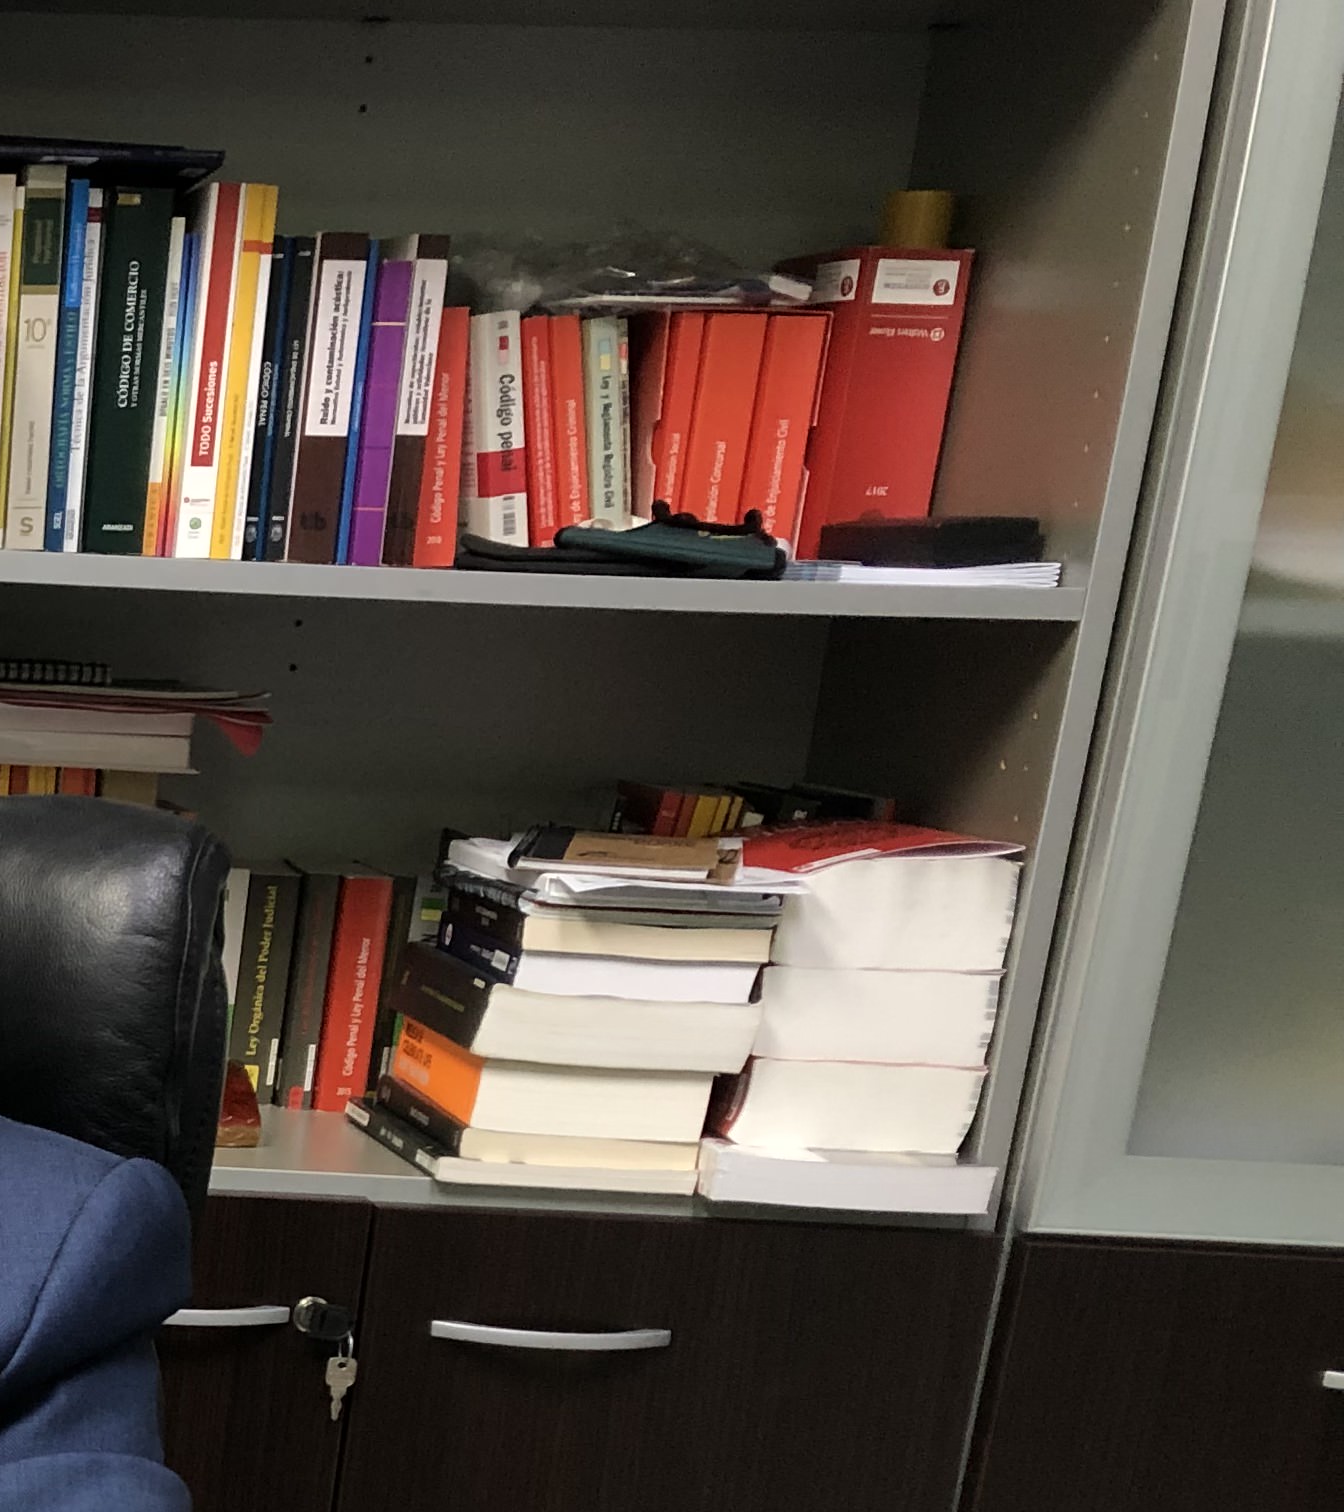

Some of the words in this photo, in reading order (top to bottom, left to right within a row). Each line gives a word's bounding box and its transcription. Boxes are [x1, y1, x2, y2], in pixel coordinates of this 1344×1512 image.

[124, 261, 140, 330] COMERCIO
[121, 334, 133, 351] DE
[324, 316, 340, 385] contaminación
[73, 379, 86, 388] la
[116, 356, 132, 407] CÓDIGO
[202, 361, 218, 422] Sucesiones
[262, 361, 271, 397] CÓDIGO
[73, 391, 85, 404] de
[320, 397, 331, 425] Ruido
[439, 404, 448, 416] del
[496, 373, 515, 427] Código
[258, 399, 269, 426] PENAL
[566, 399, 577, 434] Criminal
[198, 426, 213, 456] TODO
[436, 419, 447, 442] Penal
[777, 419, 789, 437] Civil
[498, 430, 517, 472] penal
[710, 441, 726, 482] Concursal
[433, 467, 444, 490] Penal
[769, 440, 786, 503] Enjuiciamiento
[866, 486, 888, 496] 2017
[431, 493, 443, 522] Código
[571, 499, 581, 511] de
[767, 505, 776, 515] de
[263, 885, 278, 928] Judicial
[258, 931, 272, 962] Poder
[255, 965, 267, 982] del
[355, 965, 366, 978] del
[352, 980, 364, 1001] Penal
[249, 985, 265, 1033] Orgánica
[351, 1003, 364, 1016] Ley
[245, 1037, 261, 1056] Ley
[347, 1025, 359, 1045] Penal
[342, 1048, 357, 1076] Código
